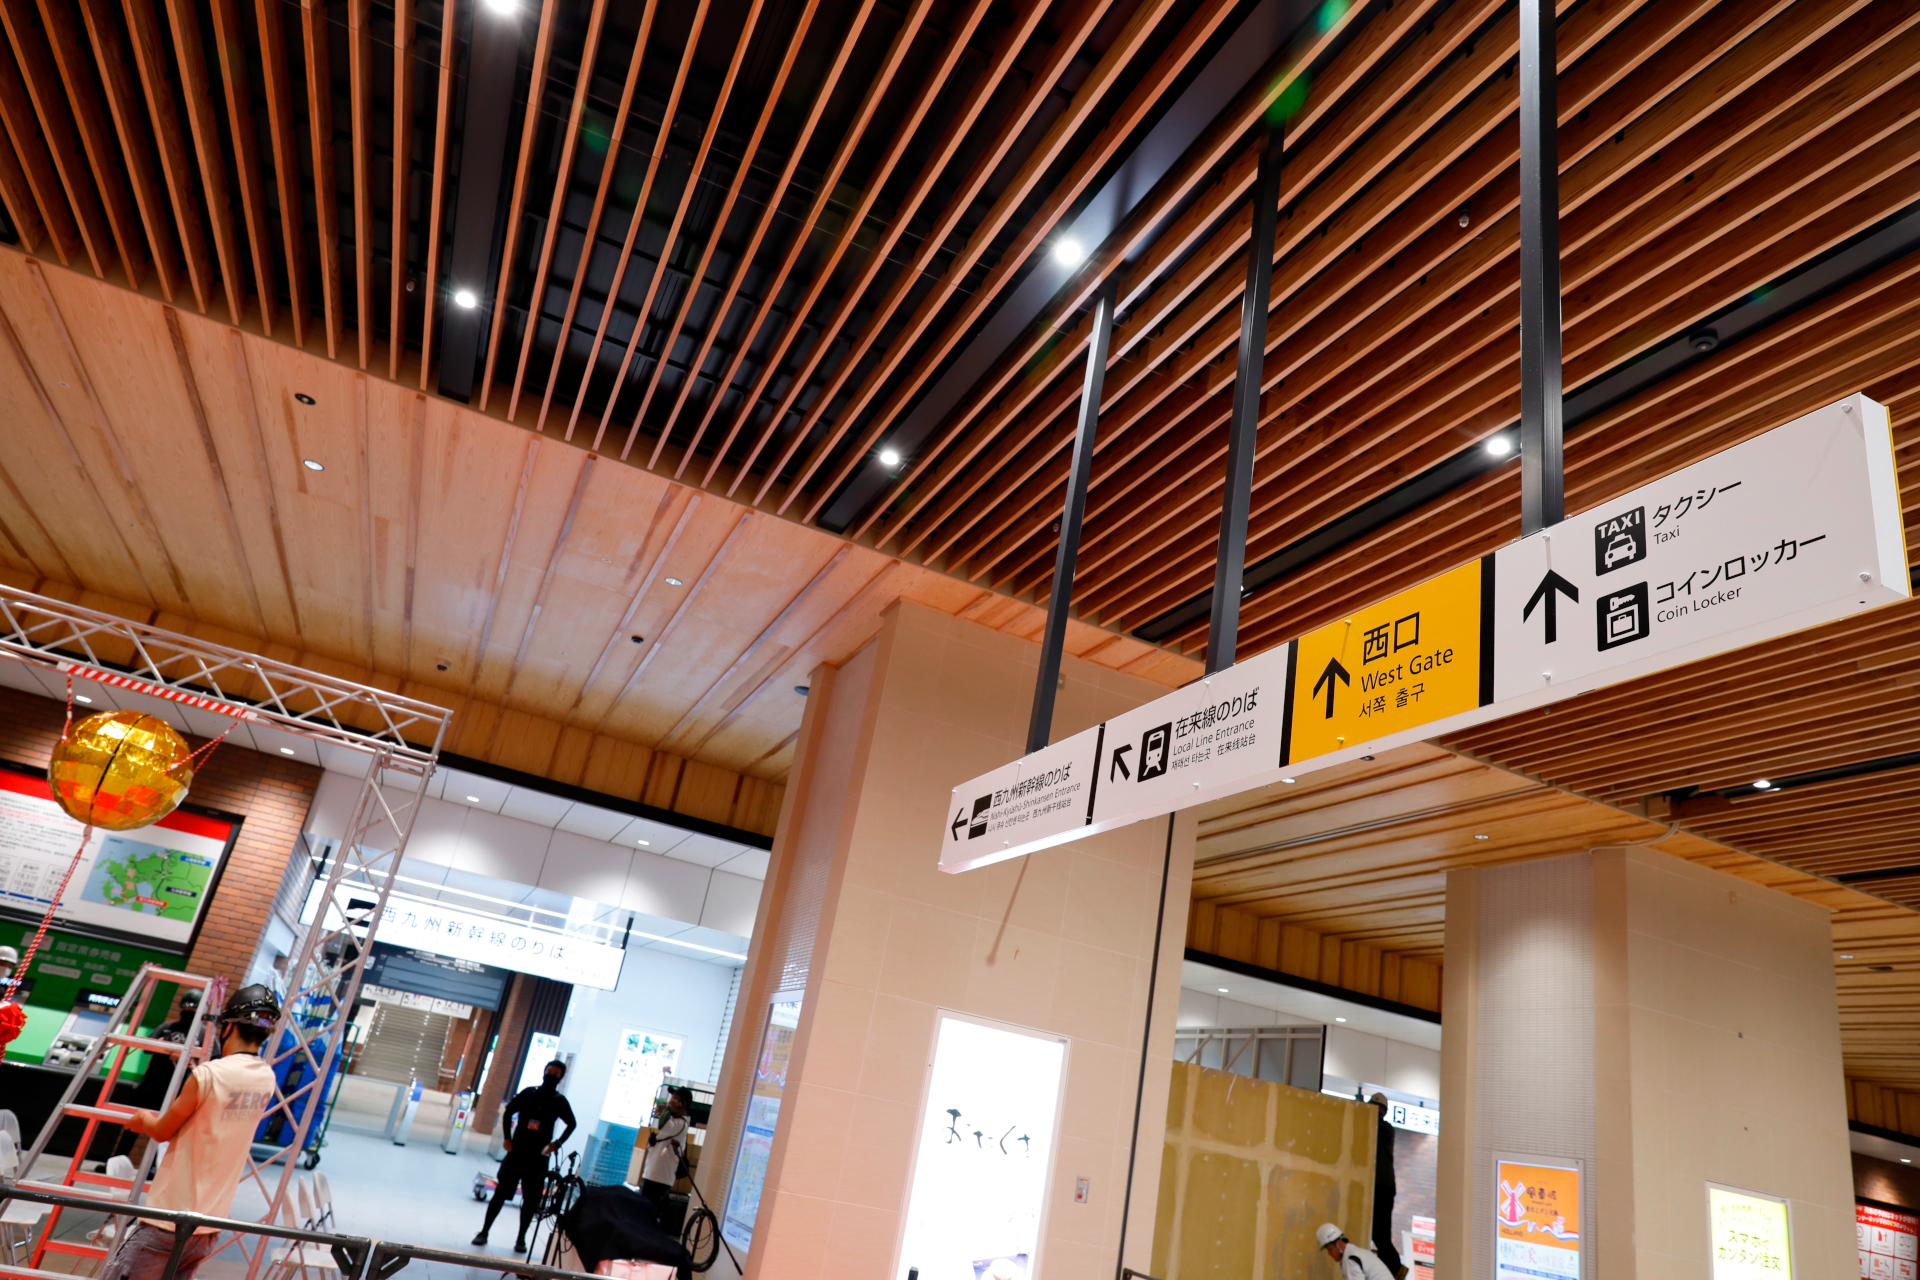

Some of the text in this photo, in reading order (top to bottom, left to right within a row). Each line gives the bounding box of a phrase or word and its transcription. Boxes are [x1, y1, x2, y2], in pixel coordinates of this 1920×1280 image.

[1652, 480, 1741, 528] タクシー
[1598, 510, 1640, 539] TAXI
[1654, 525, 1680, 544] Taxi
[1656, 534, 1826, 604] コインロッカー
[1657, 586, 1742, 623] Coin Locker
[1363, 611, 1420, 666] 西口
[1361, 648, 1453, 692] West Gate
[1175, 686, 1260, 740] 在来線のりば
[1359, 683, 1425, 718] 서쪽 출구
[1173, 719, 1255, 756] Local Line Entrance
[1217, 733, 1256, 757] 在来线站台
[993, 761, 1073, 808] 西九州新幹線のりば
[1054, 782, 1081, 798] Entrance
[379, 904, 567, 960] 西九州新幹線のりば
[224, 1091, 271, 1110] ZERO
[1717, 1244, 1782, 1271] カンタン注文
[1728, 1229, 1771, 1251] スマホで
